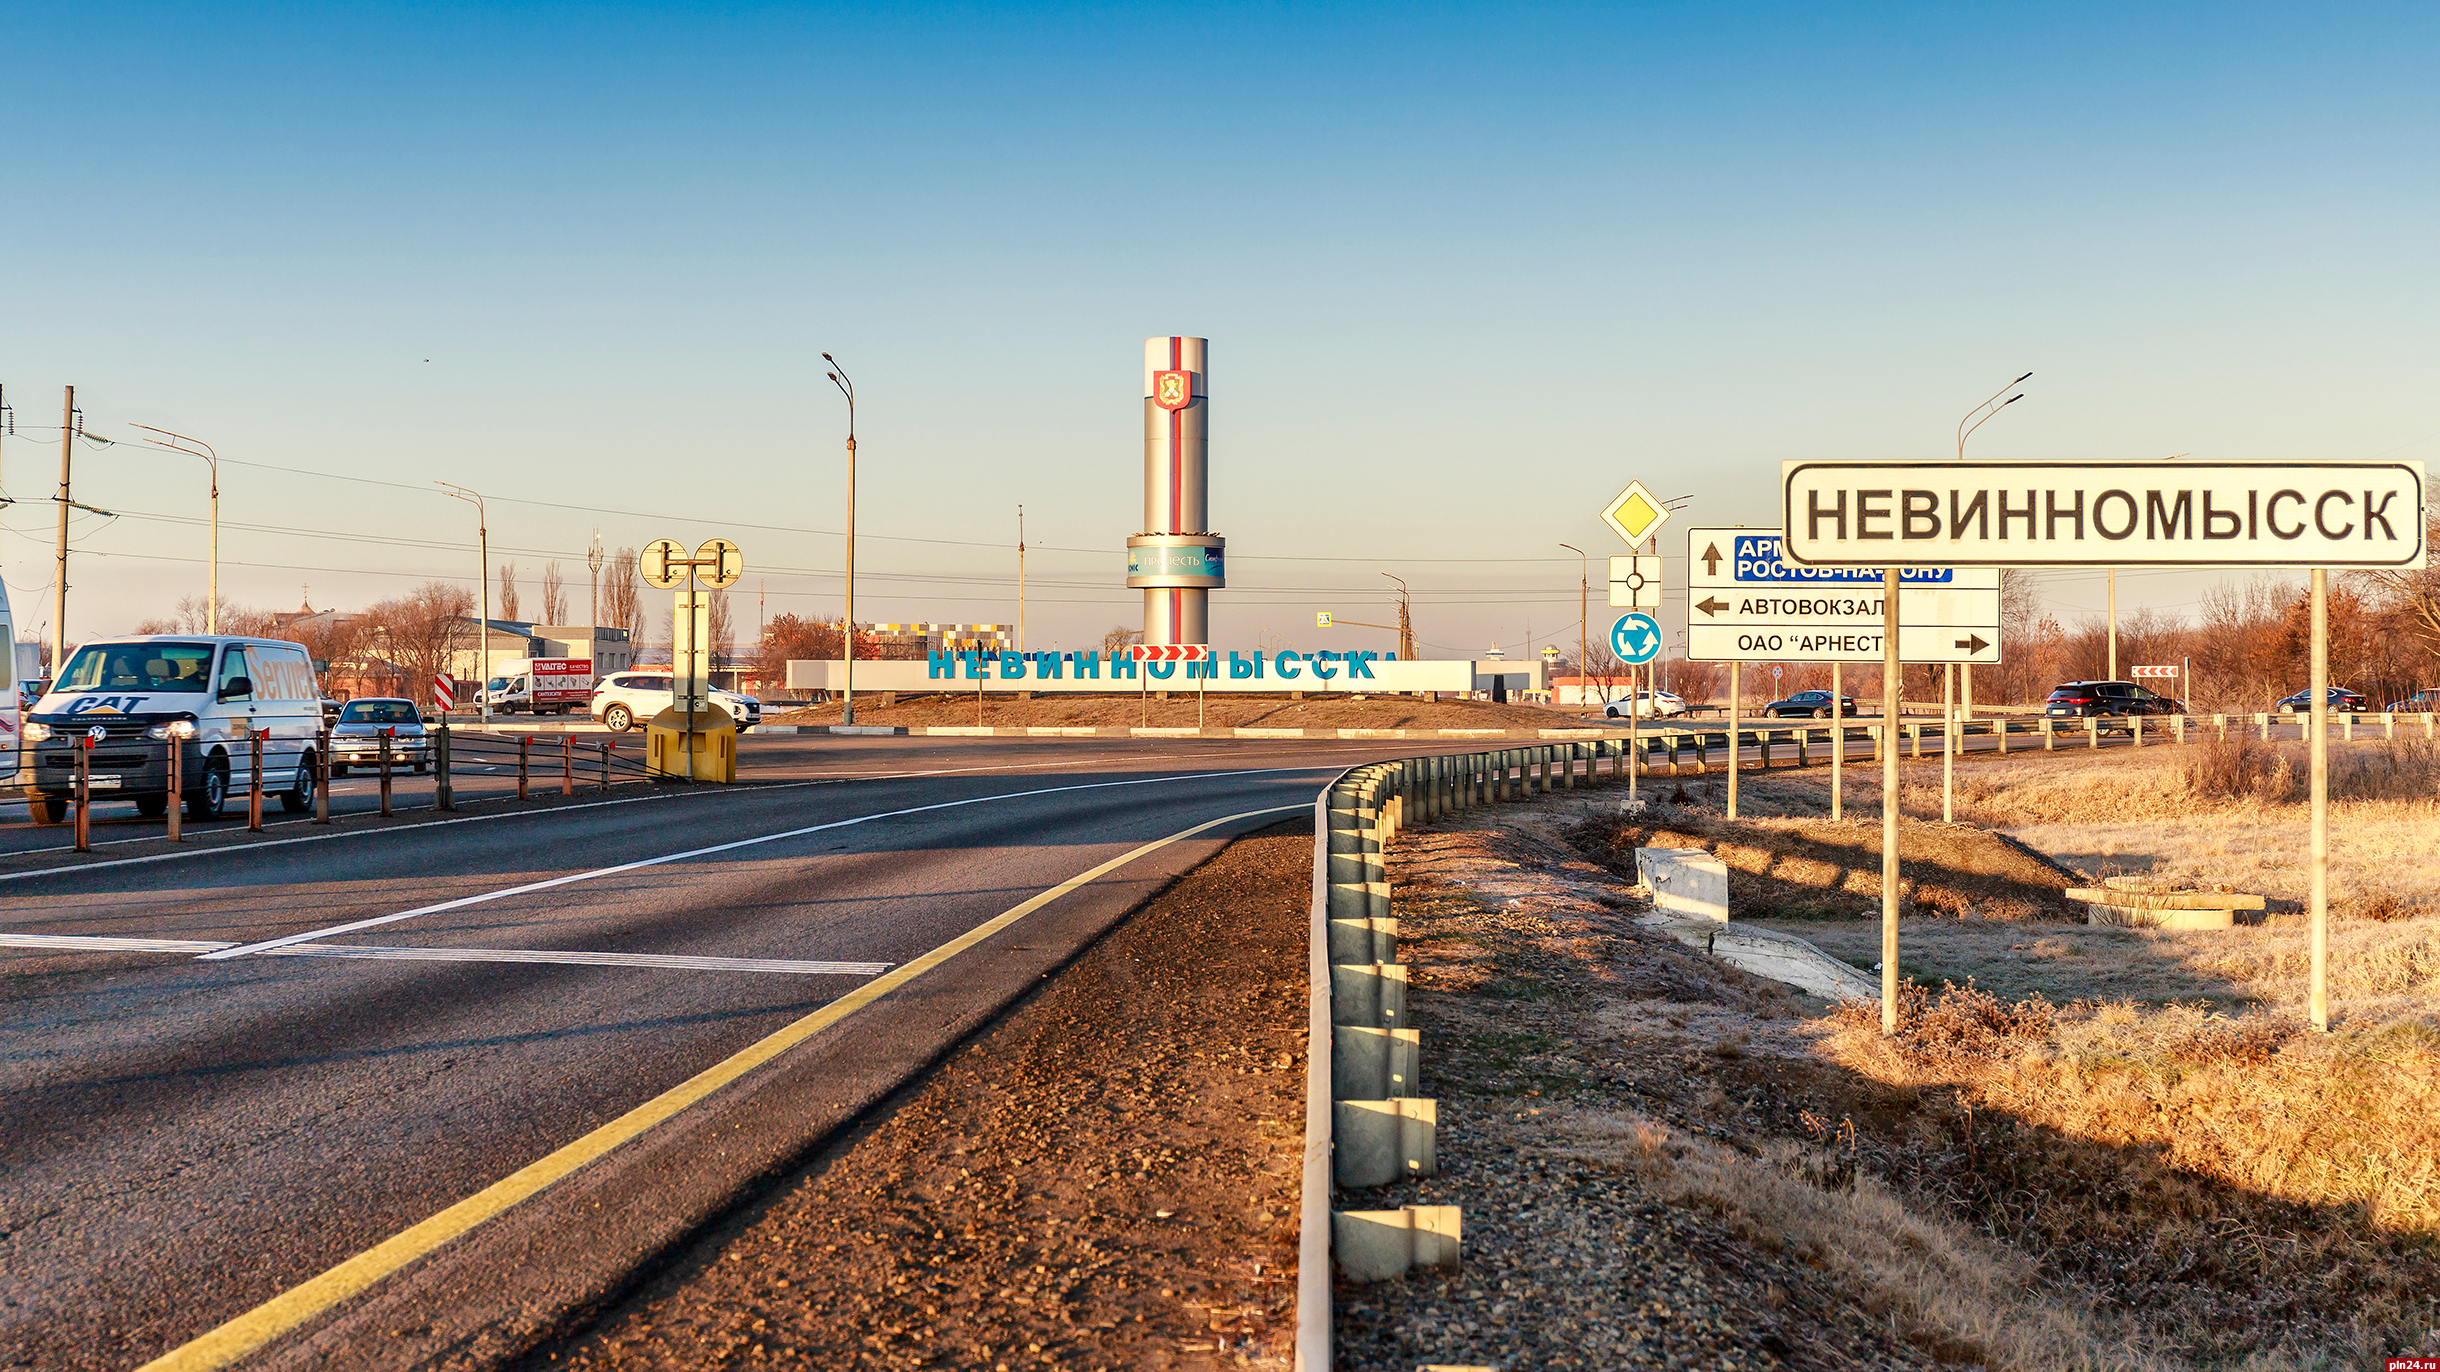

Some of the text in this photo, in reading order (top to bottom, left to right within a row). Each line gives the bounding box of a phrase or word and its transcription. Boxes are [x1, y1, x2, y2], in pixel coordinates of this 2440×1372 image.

[1808, 489, 2398, 541] НЕВИННОМЫССК
[1739, 599, 1885, 615] АВТОВОКЗАЛ
[1738, 635, 1783, 651] ОАО
[541, 663, 567, 671] VALTEC
[928, 650, 1376, 680] НЕВИННОМЫССК
[66, 697, 150, 714] CAT
